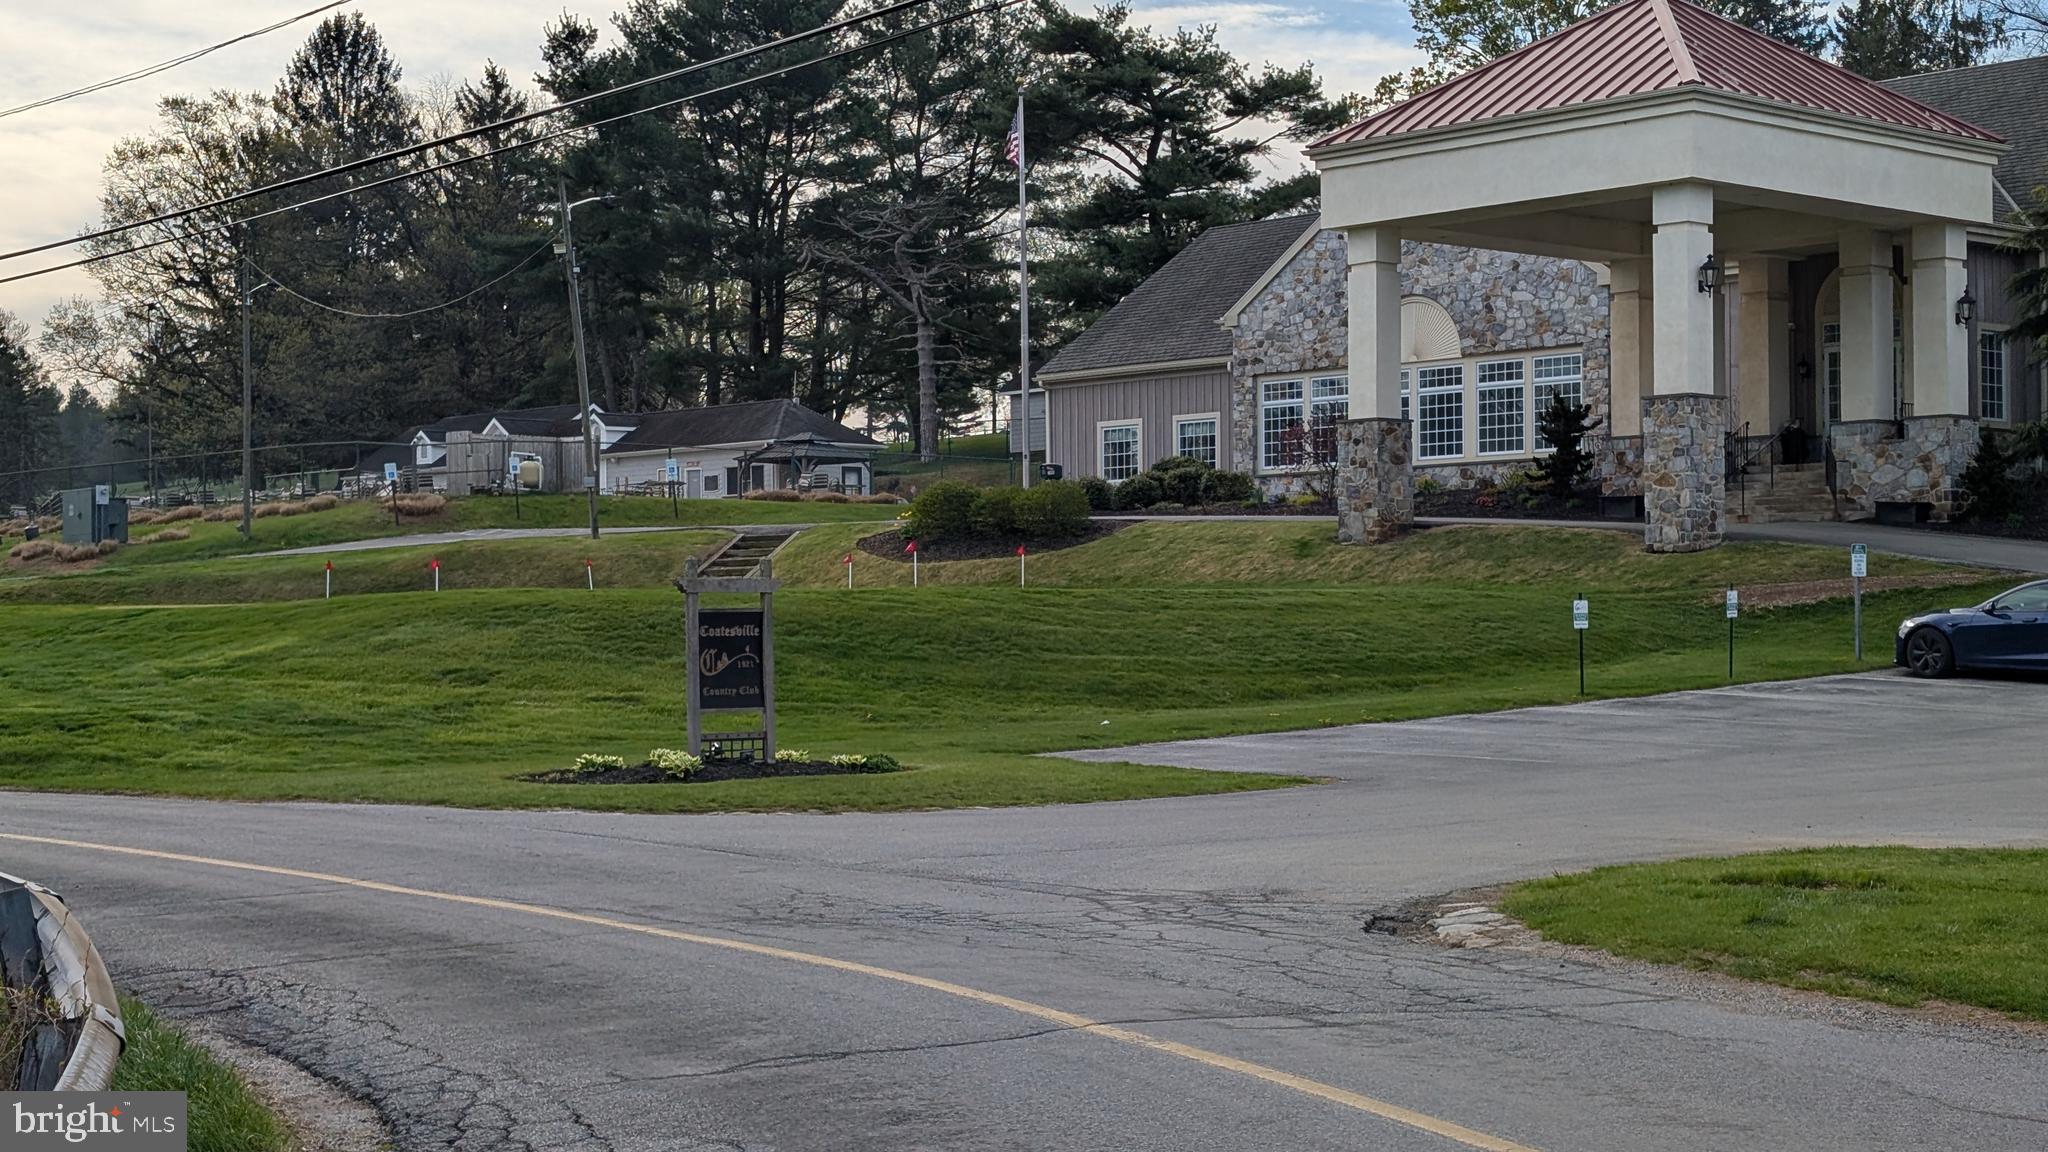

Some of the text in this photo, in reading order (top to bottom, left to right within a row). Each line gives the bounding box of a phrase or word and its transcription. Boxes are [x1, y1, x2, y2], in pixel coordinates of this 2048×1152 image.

[700, 624, 760, 637] Coatesville
[703, 686, 760, 696] Country Club
